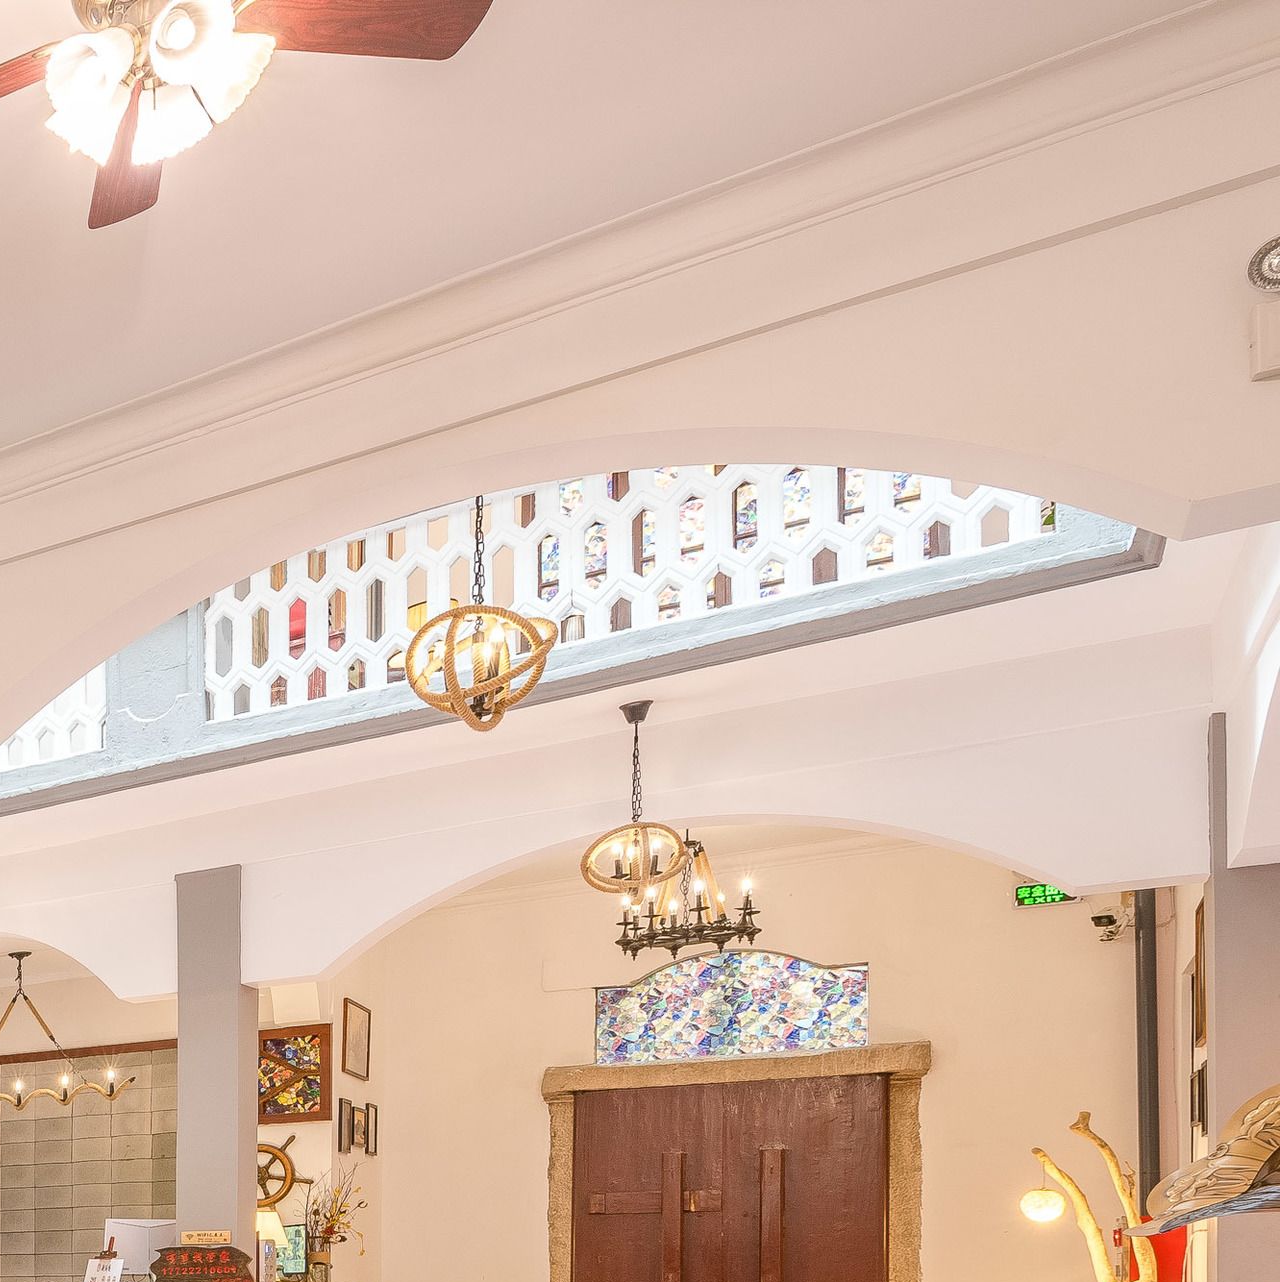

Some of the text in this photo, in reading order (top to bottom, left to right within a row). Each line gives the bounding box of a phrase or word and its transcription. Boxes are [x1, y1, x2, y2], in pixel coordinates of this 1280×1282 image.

[1017, 885, 1065, 898] 安全出
[1024, 895, 1063, 905] EXIT
